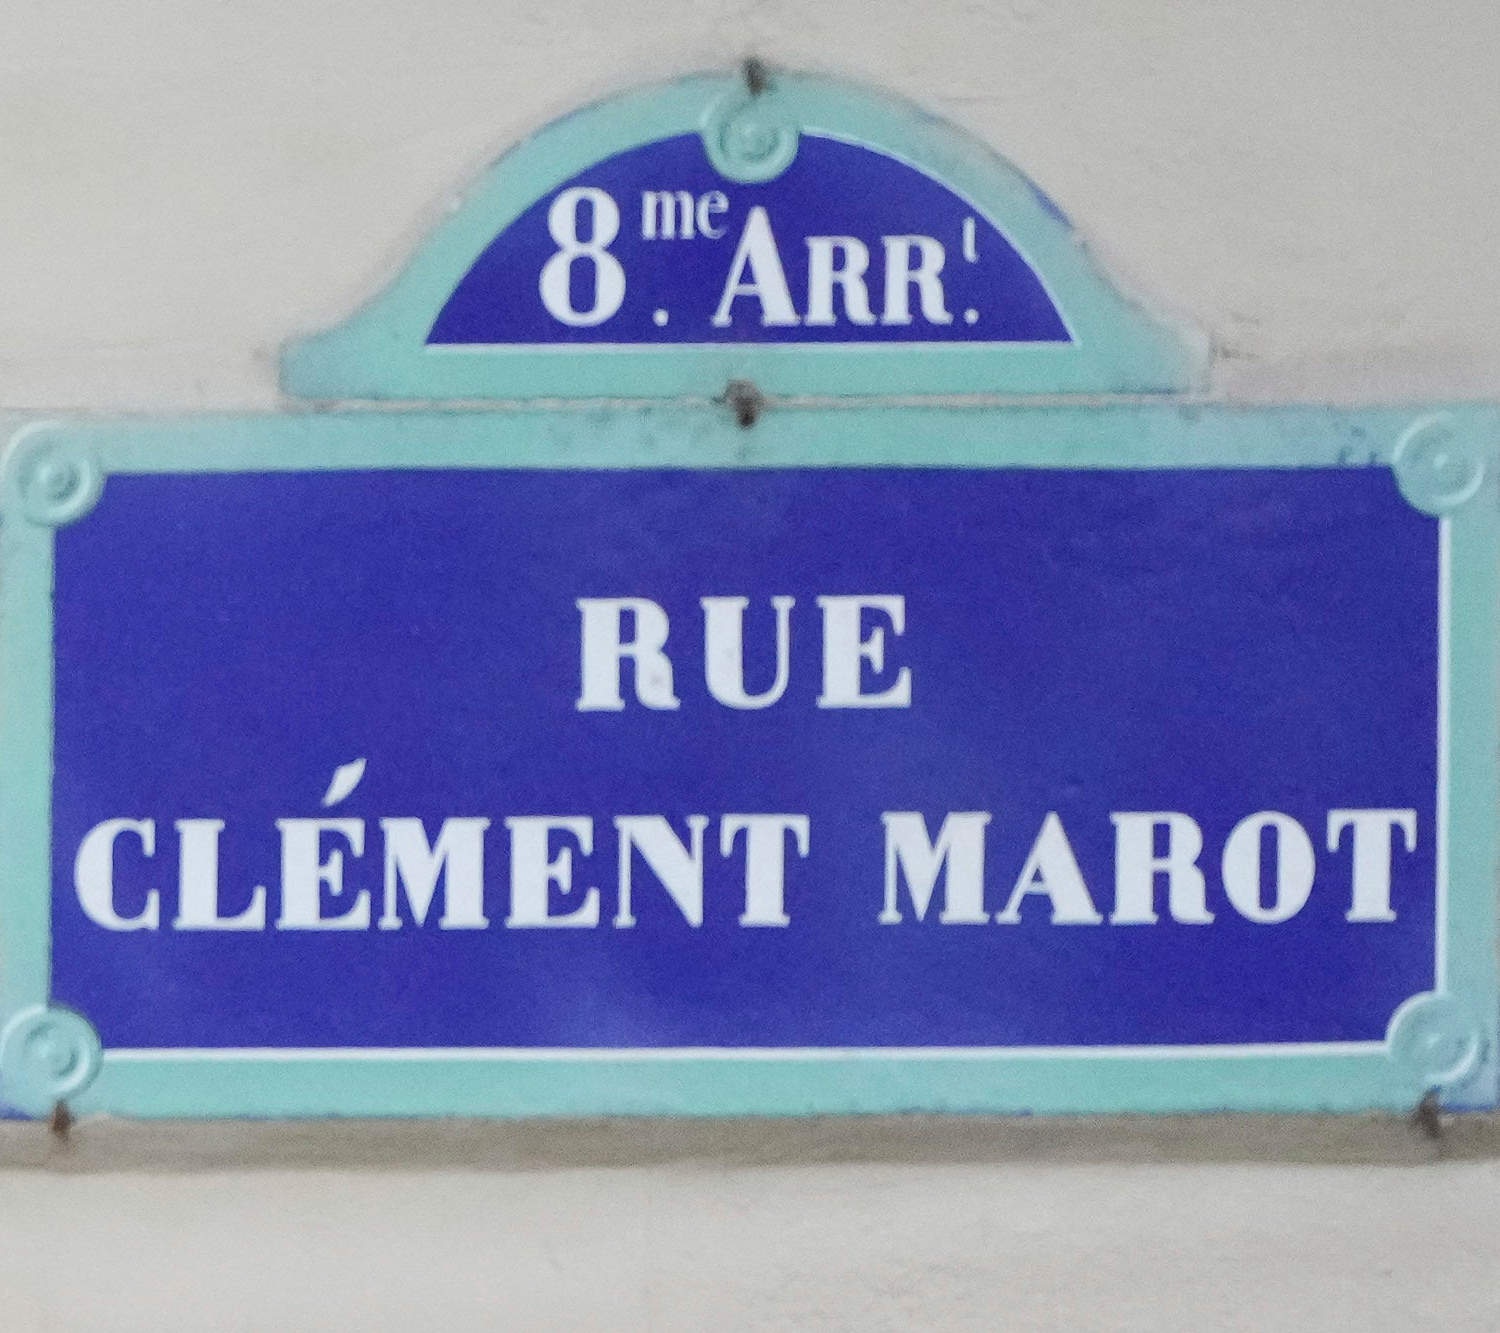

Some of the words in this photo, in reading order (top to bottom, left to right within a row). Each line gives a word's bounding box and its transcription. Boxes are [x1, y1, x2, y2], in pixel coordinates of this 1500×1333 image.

[577, 595, 912, 710] RUE
[74, 758, 810, 930] CLÉMENT
[880, 809, 1417, 924] MAROT
